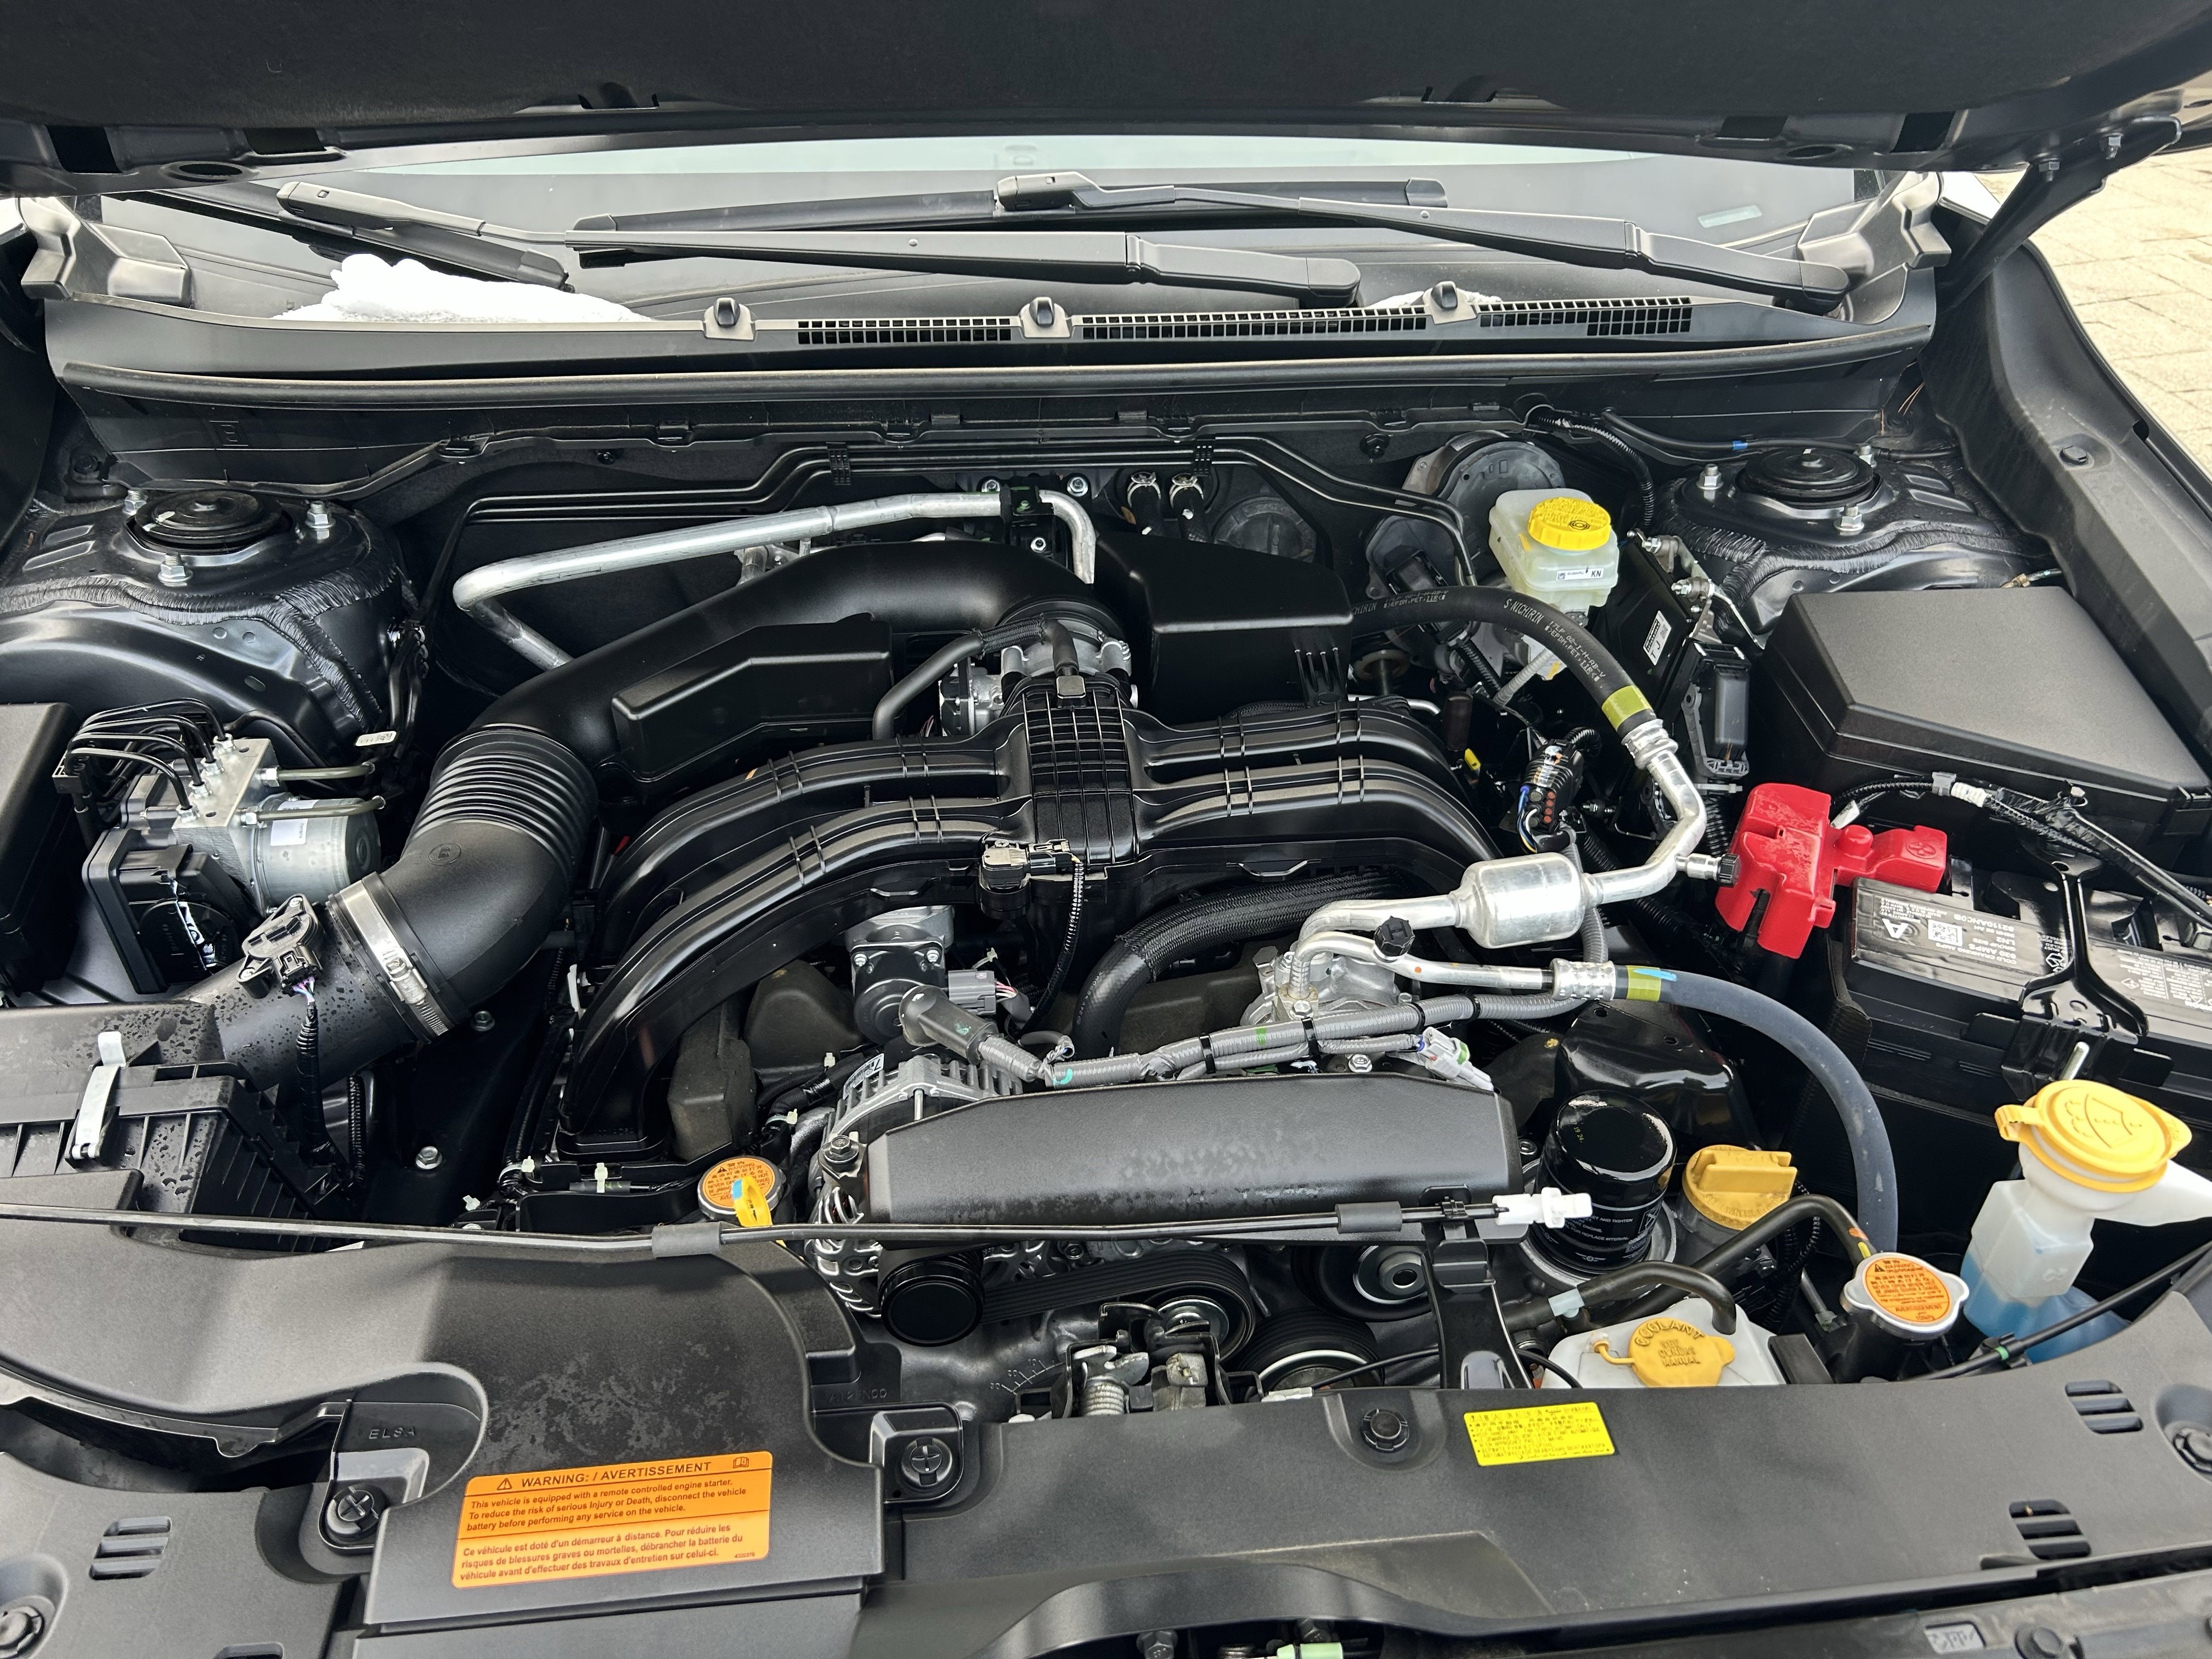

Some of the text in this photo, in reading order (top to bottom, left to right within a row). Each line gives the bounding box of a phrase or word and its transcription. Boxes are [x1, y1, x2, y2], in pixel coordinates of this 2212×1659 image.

[1386, 921, 1408, 940] H
[1996, 936, 2015, 945] LN2
[1936, 943, 2017, 964] COLD CRANKING AMPS
[1968, 944, 1996, 956] AMPS
[1972, 938, 2016, 951] GROUP SIZE
[1635, 1321, 1705, 1347] COOLANT
[522, 1462, 712, 1487] WARNING: / AVERTISSEMENT
[471, 1500, 488, 1509] This
[492, 1498, 521, 1507] vehicle
[533, 1492, 571, 1504] equipped
[574, 1491, 590, 1499] with
[600, 1489, 629, 1497] remote
[631, 1484, 672, 1494] controlled
[675, 1482, 702, 1491] engine
[704, 1479, 733, 1487] starter.
[482, 1510, 510, 1519] reduce
[528, 1506, 543, 1514] risk
[556, 1503, 587, 1511] serious
[590, 1500, 613, 1510] Injury
[627, 1497, 652, 1505] Death,
[655, 1493, 700, 1503] disconnect
[702, 1490, 715, 1498] the
[718, 1488, 746, 1497] vehicle
[467, 1522, 496, 1531] battery
[499, 1519, 525, 1528] before
[528, 1515, 574, 1527] performing
[594, 1509, 623, 1519] service
[654, 1504, 686, 1514] vehicle.
[461, 1559, 493, 1568] risques
[509, 1553, 550, 1564] blessures
[553, 1551, 581, 1561] graves
[597, 1545, 638, 1556] mortelles,
[641, 1541, 687, 1551] débrancher
[689, 1538, 696, 1547] la
[698, 1535, 730, 1545] batterie
[732, 1533, 743, 1542] du
[464, 1548, 475, 1556] Ce
[477, 1544, 512, 1555] véhicule
[515, 1543, 527, 1551] est
[530, 1542, 549, 1550] doté
[551, 1539, 569, 1548] d'un
[572, 1535, 615, 1546] démarreur
[625, 1531, 662, 1541] distance.
[665, 1528, 684, 1537] Pour
[687, 1525, 716, 1535] réduire
[719, 1524, 731, 1532] les
[460, 1571, 496, 1580] véhicule
[499, 1567, 522, 1576] avant
[524, 1563, 569, 1575] d'effectuer
[572, 1561, 587, 1570] des
[590, 1559, 621, 1567] travaux
[623, 1554, 668, 1565] d'entretien
[686, 1549, 719, 1558] celui-ci.
